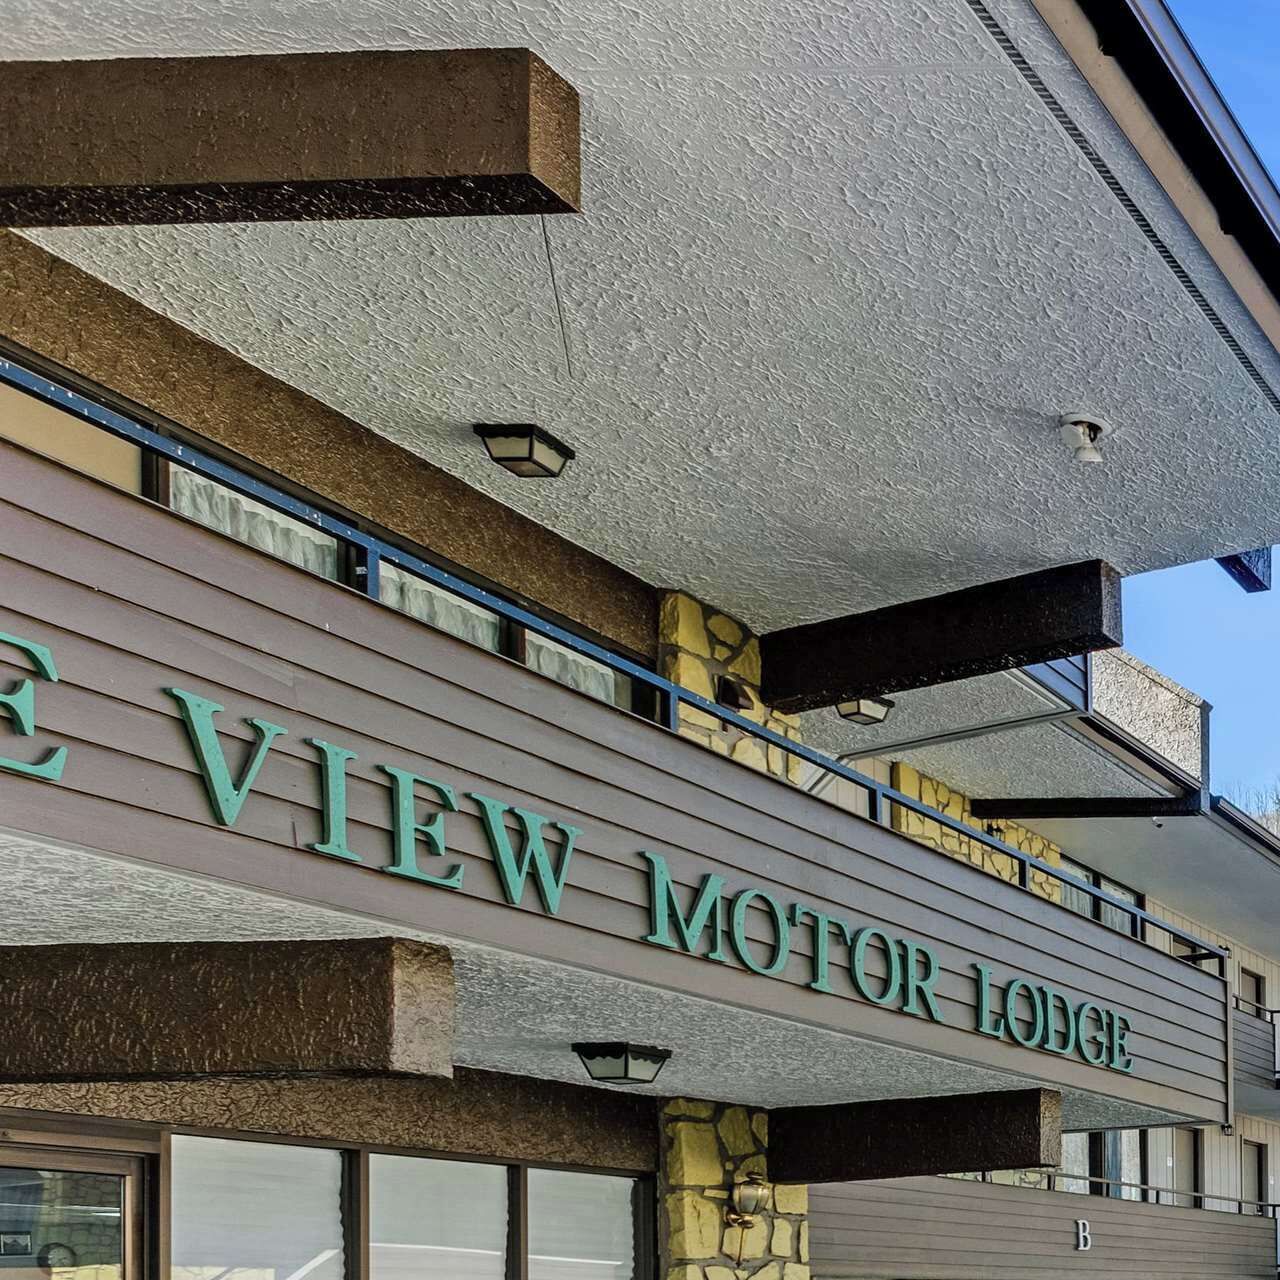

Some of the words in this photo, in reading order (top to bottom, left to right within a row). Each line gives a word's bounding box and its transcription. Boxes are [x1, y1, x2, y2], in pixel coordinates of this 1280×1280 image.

[165, 687, 585, 915] VIEW
[640, 850, 944, 1022] MOTOR
[971, 962, 1134, 1074] LODGE
[1075, 1219, 1092, 1250] B
